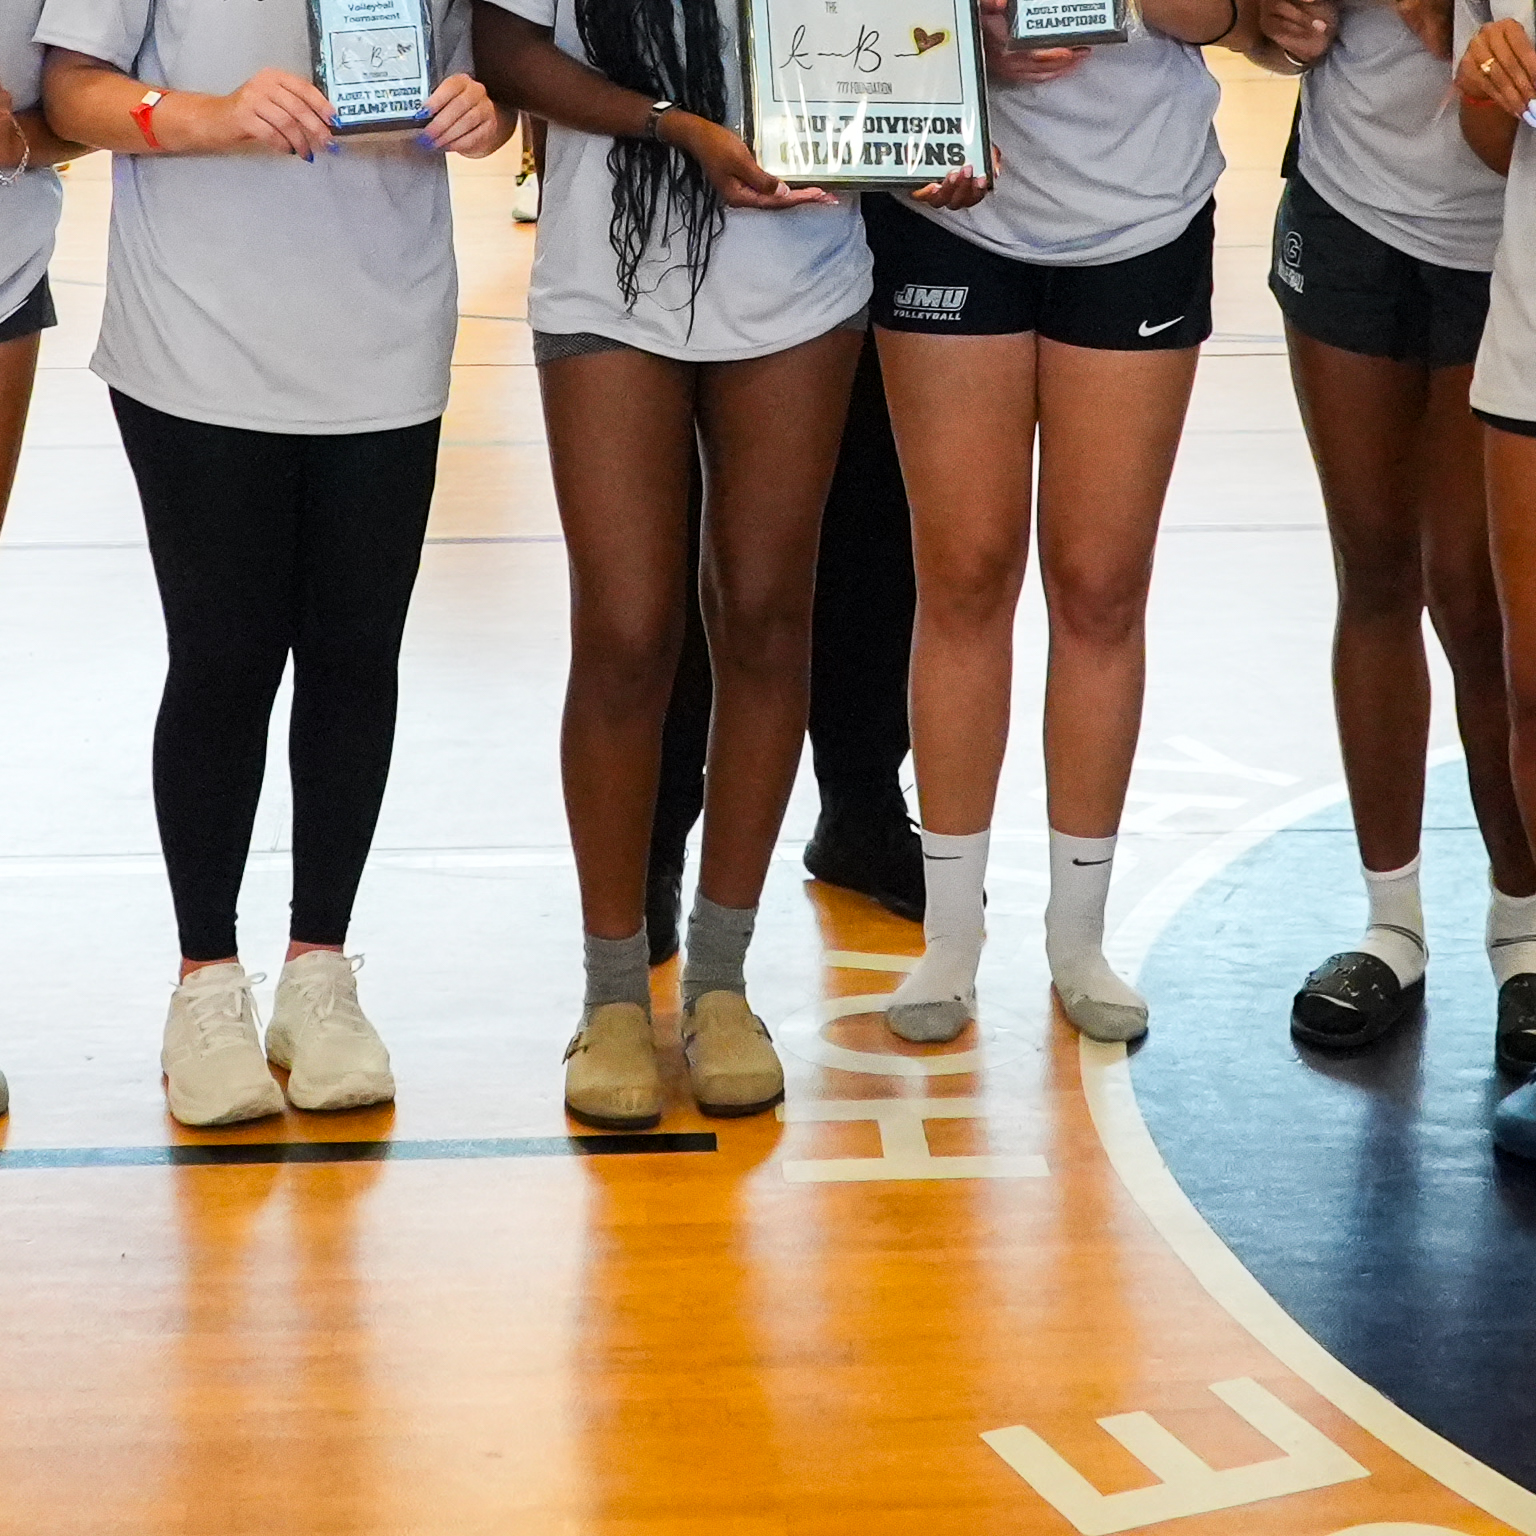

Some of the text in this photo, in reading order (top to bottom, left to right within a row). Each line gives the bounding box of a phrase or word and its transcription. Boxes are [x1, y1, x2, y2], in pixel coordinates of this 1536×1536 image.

[825, 1, 838, 14] THE
[1026, 14, 1107, 30] CHAMPIONS
[338, 98, 423, 116] CHAMPIONS
[863, 116, 963, 134] DIVISION
[895, 285, 967, 310] JMU
[893, 309, 962, 321] VOLLEYBALL
